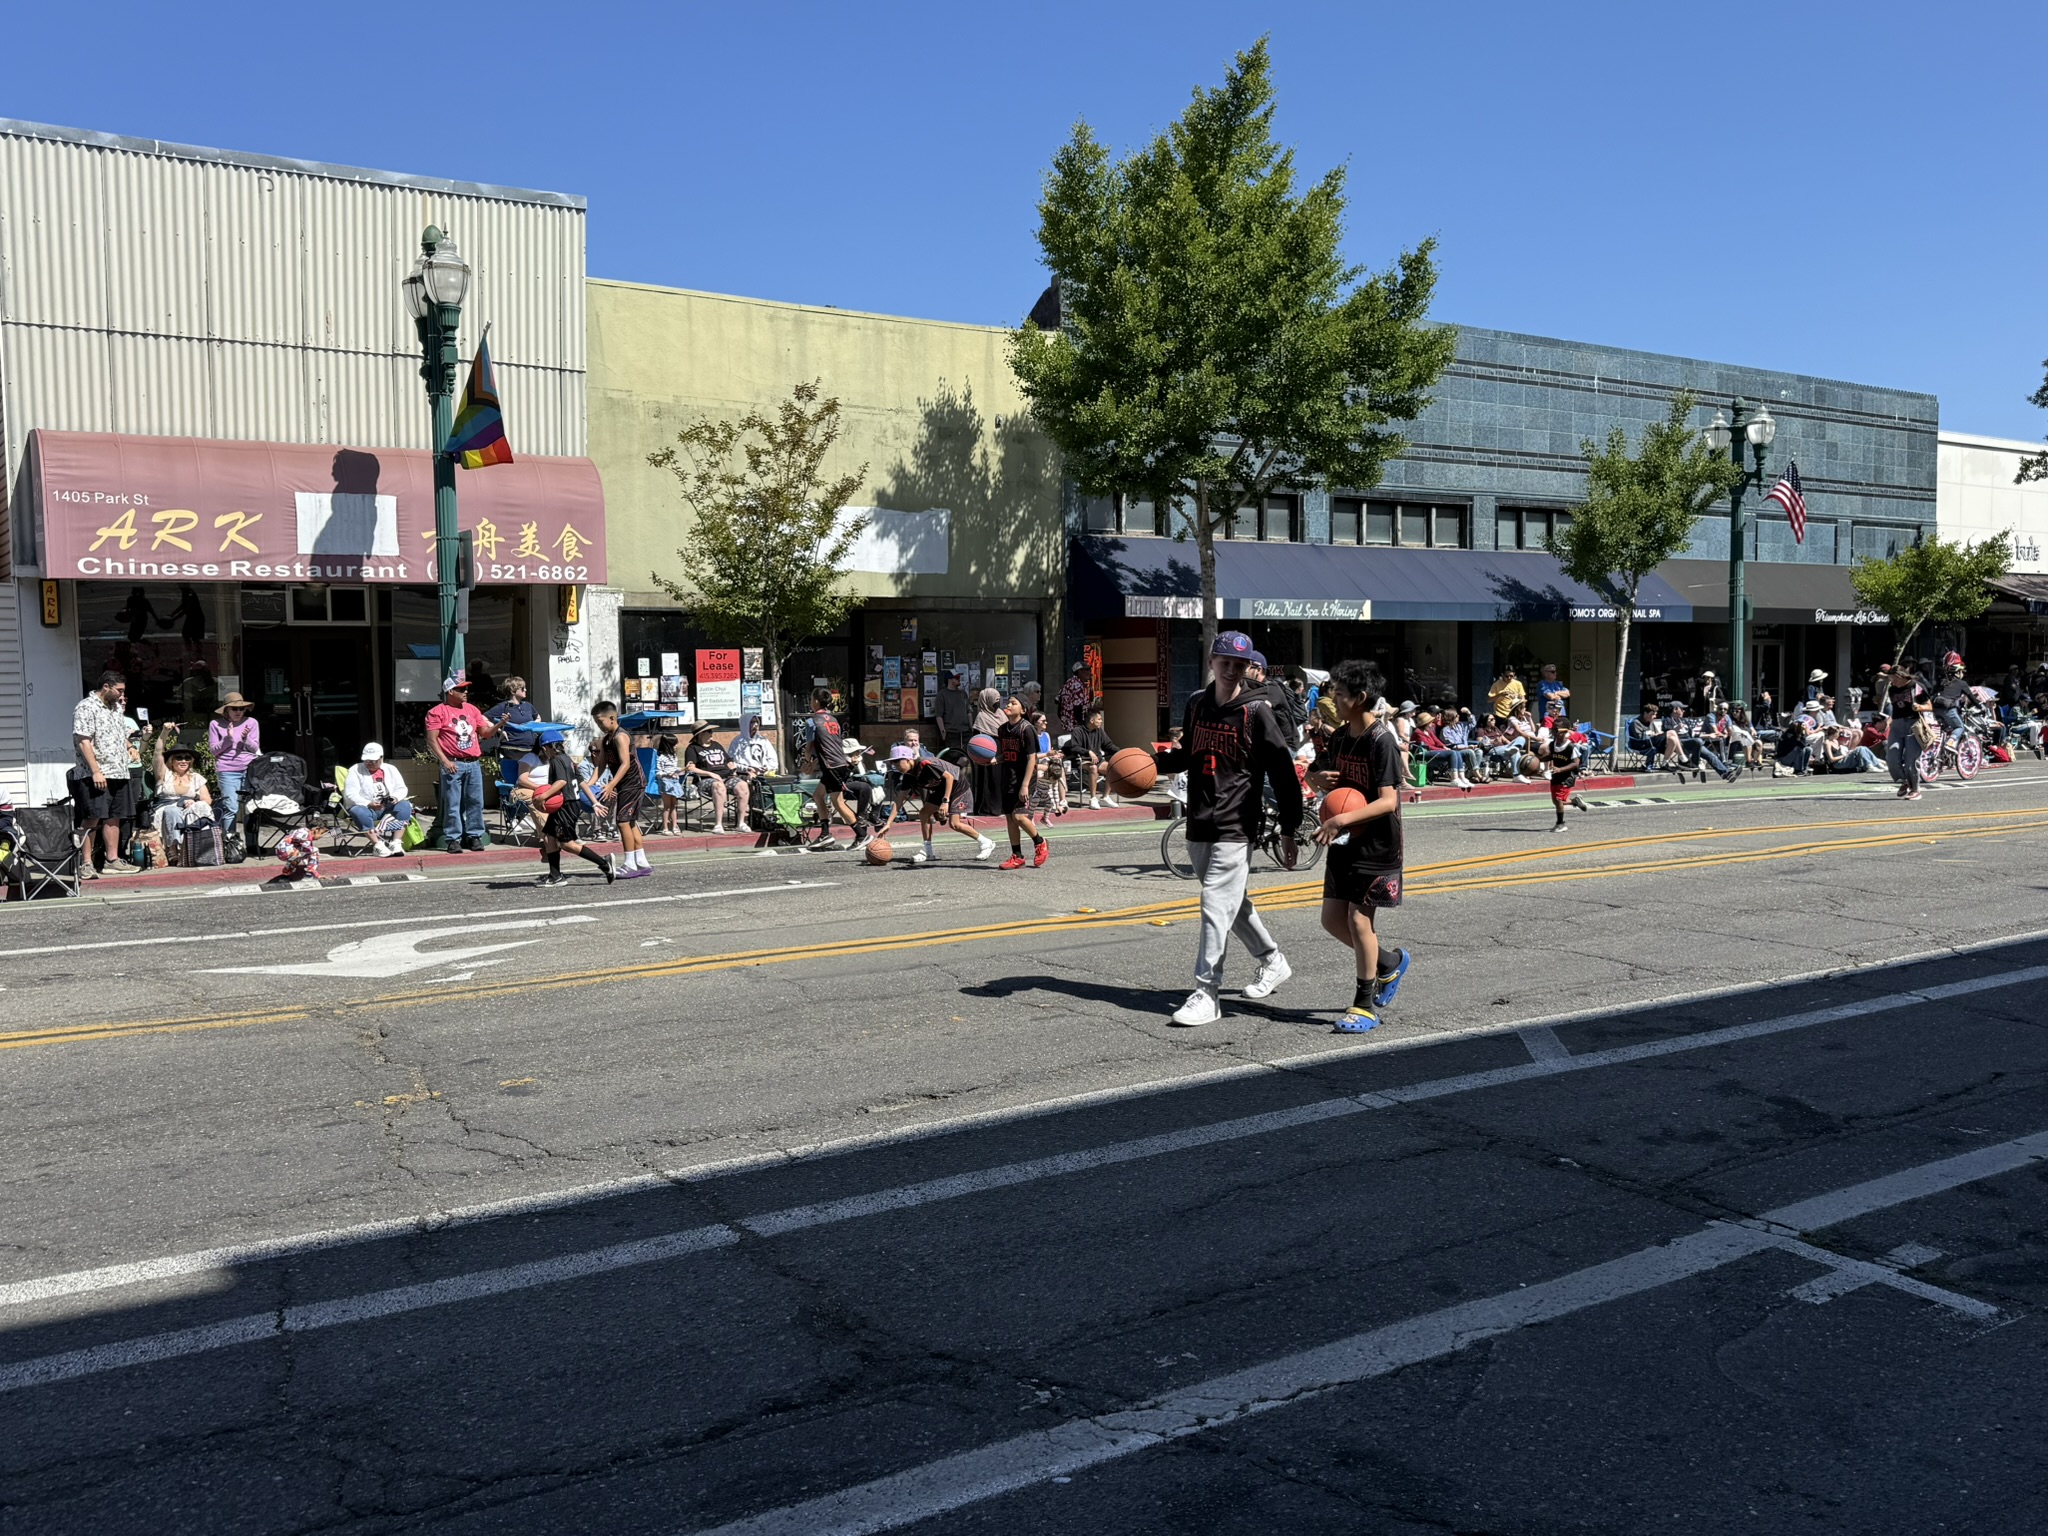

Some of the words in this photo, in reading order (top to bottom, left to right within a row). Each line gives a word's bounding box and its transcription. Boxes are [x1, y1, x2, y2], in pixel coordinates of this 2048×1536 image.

[52, 490, 90, 503] 1405
[94, 492, 129, 505] Park
[133, 494, 149, 506] St
[88, 508, 263, 554] ARK
[77, 557, 220, 577] Chinese
[230, 560, 407, 579] Restaurant
[490, 564, 588, 581] 521-6862
[46, 585, 56, 619] ARK
[1254, 600, 1280, 617] Bella
[1280, 601, 1303, 617] Nail
[1303, 602, 1319, 618] Spa
[1321, 602, 1329, 616] &
[1329, 602, 1359, 620] Waxing
[1569, 607, 1596, 618] TOMO'S
[1597, 608, 1620, 618] ORGA
[1632, 608, 1647, 618] NAIL
[1648, 608, 1661, 618] SPA
[1815, 608, 1854, 624] Triumphant
[1854, 610, 1867, 625] Life
[709, 651, 728, 660] For
[702, 661, 734, 671] Lease
[1196, 720, 1237, 732] ALAMEDA
[1191, 725, 1238, 761] VIPERS
[1202, 755, 1216, 776] 2
[571, 778, 580, 800] 2
